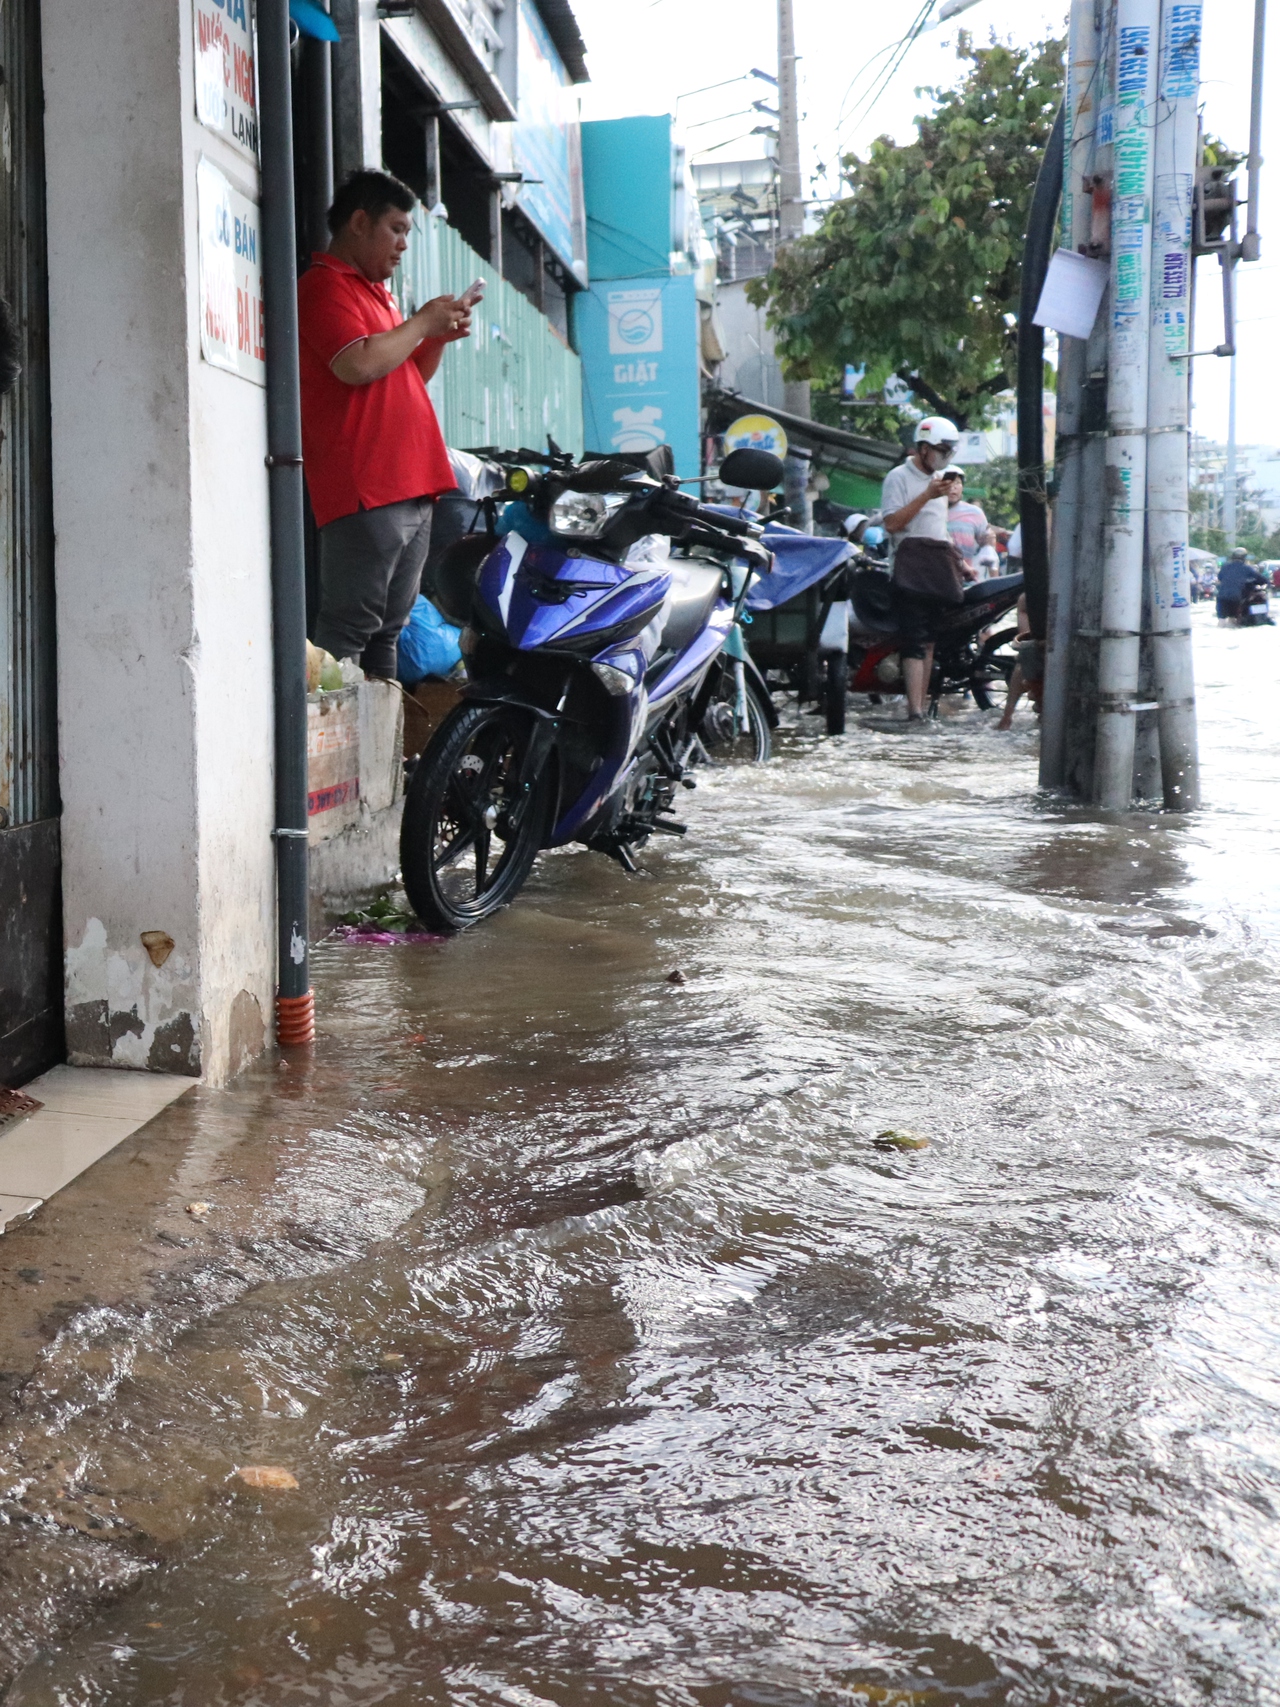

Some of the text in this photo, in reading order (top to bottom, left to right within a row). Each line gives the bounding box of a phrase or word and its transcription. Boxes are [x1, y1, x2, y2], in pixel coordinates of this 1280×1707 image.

[234, 213, 256, 265] BÁN
[237, 275, 251, 355] ĐÁ
[614, 360, 659, 386] GIẶT
